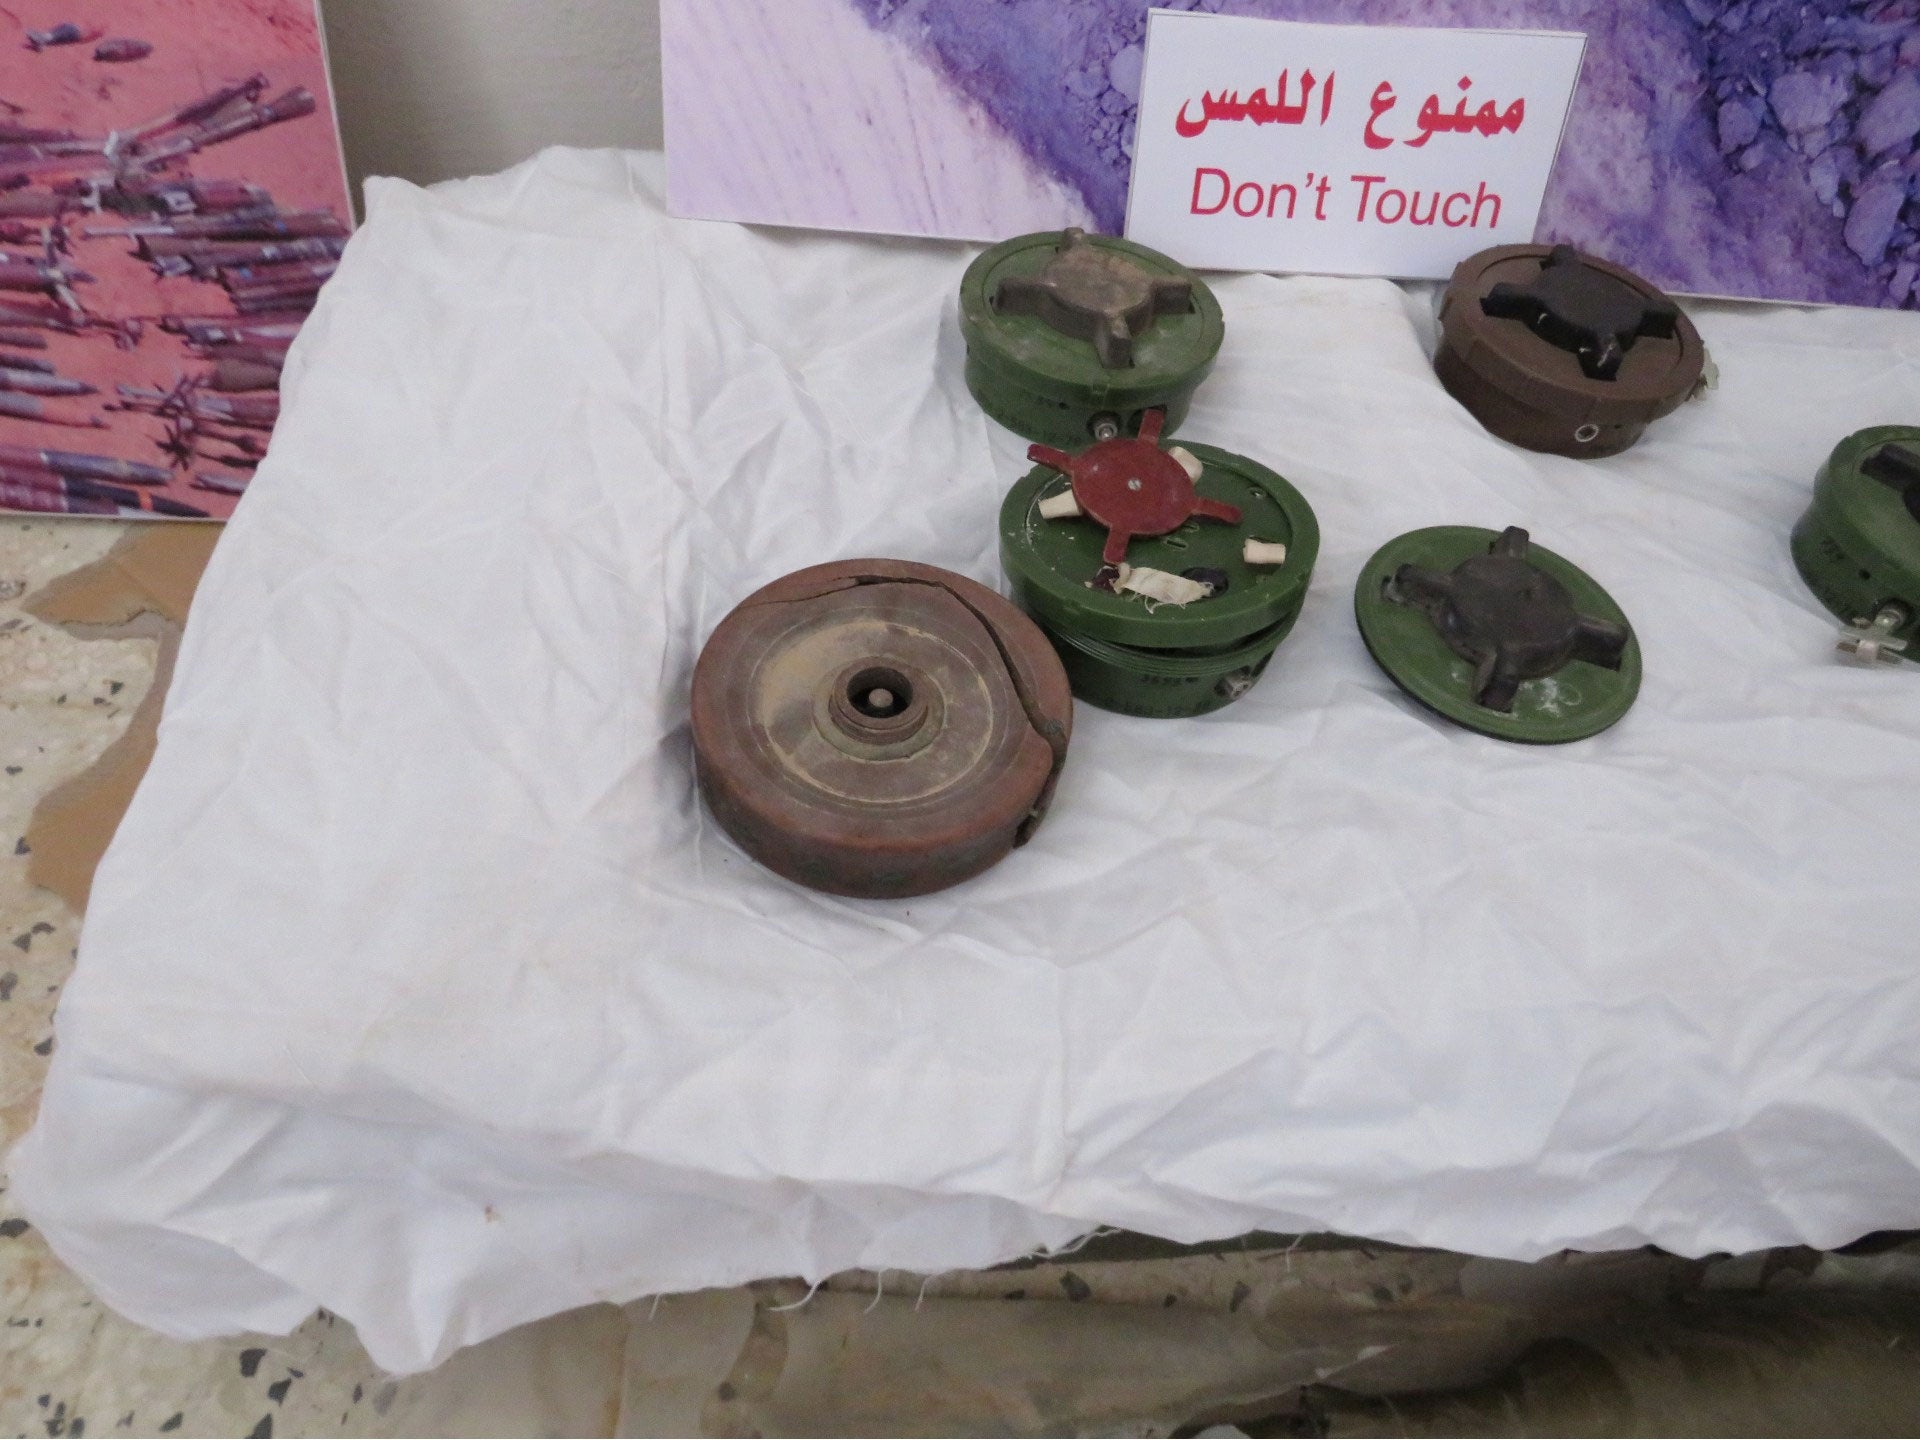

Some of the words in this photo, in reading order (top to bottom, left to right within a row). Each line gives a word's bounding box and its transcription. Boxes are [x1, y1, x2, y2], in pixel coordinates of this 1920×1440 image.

[1175, 69, 1336, 138] اللمس
[1363, 75, 1526, 150] ممنوع
[1189, 167, 1331, 221] Don't
[1350, 175, 1502, 228] Touch
